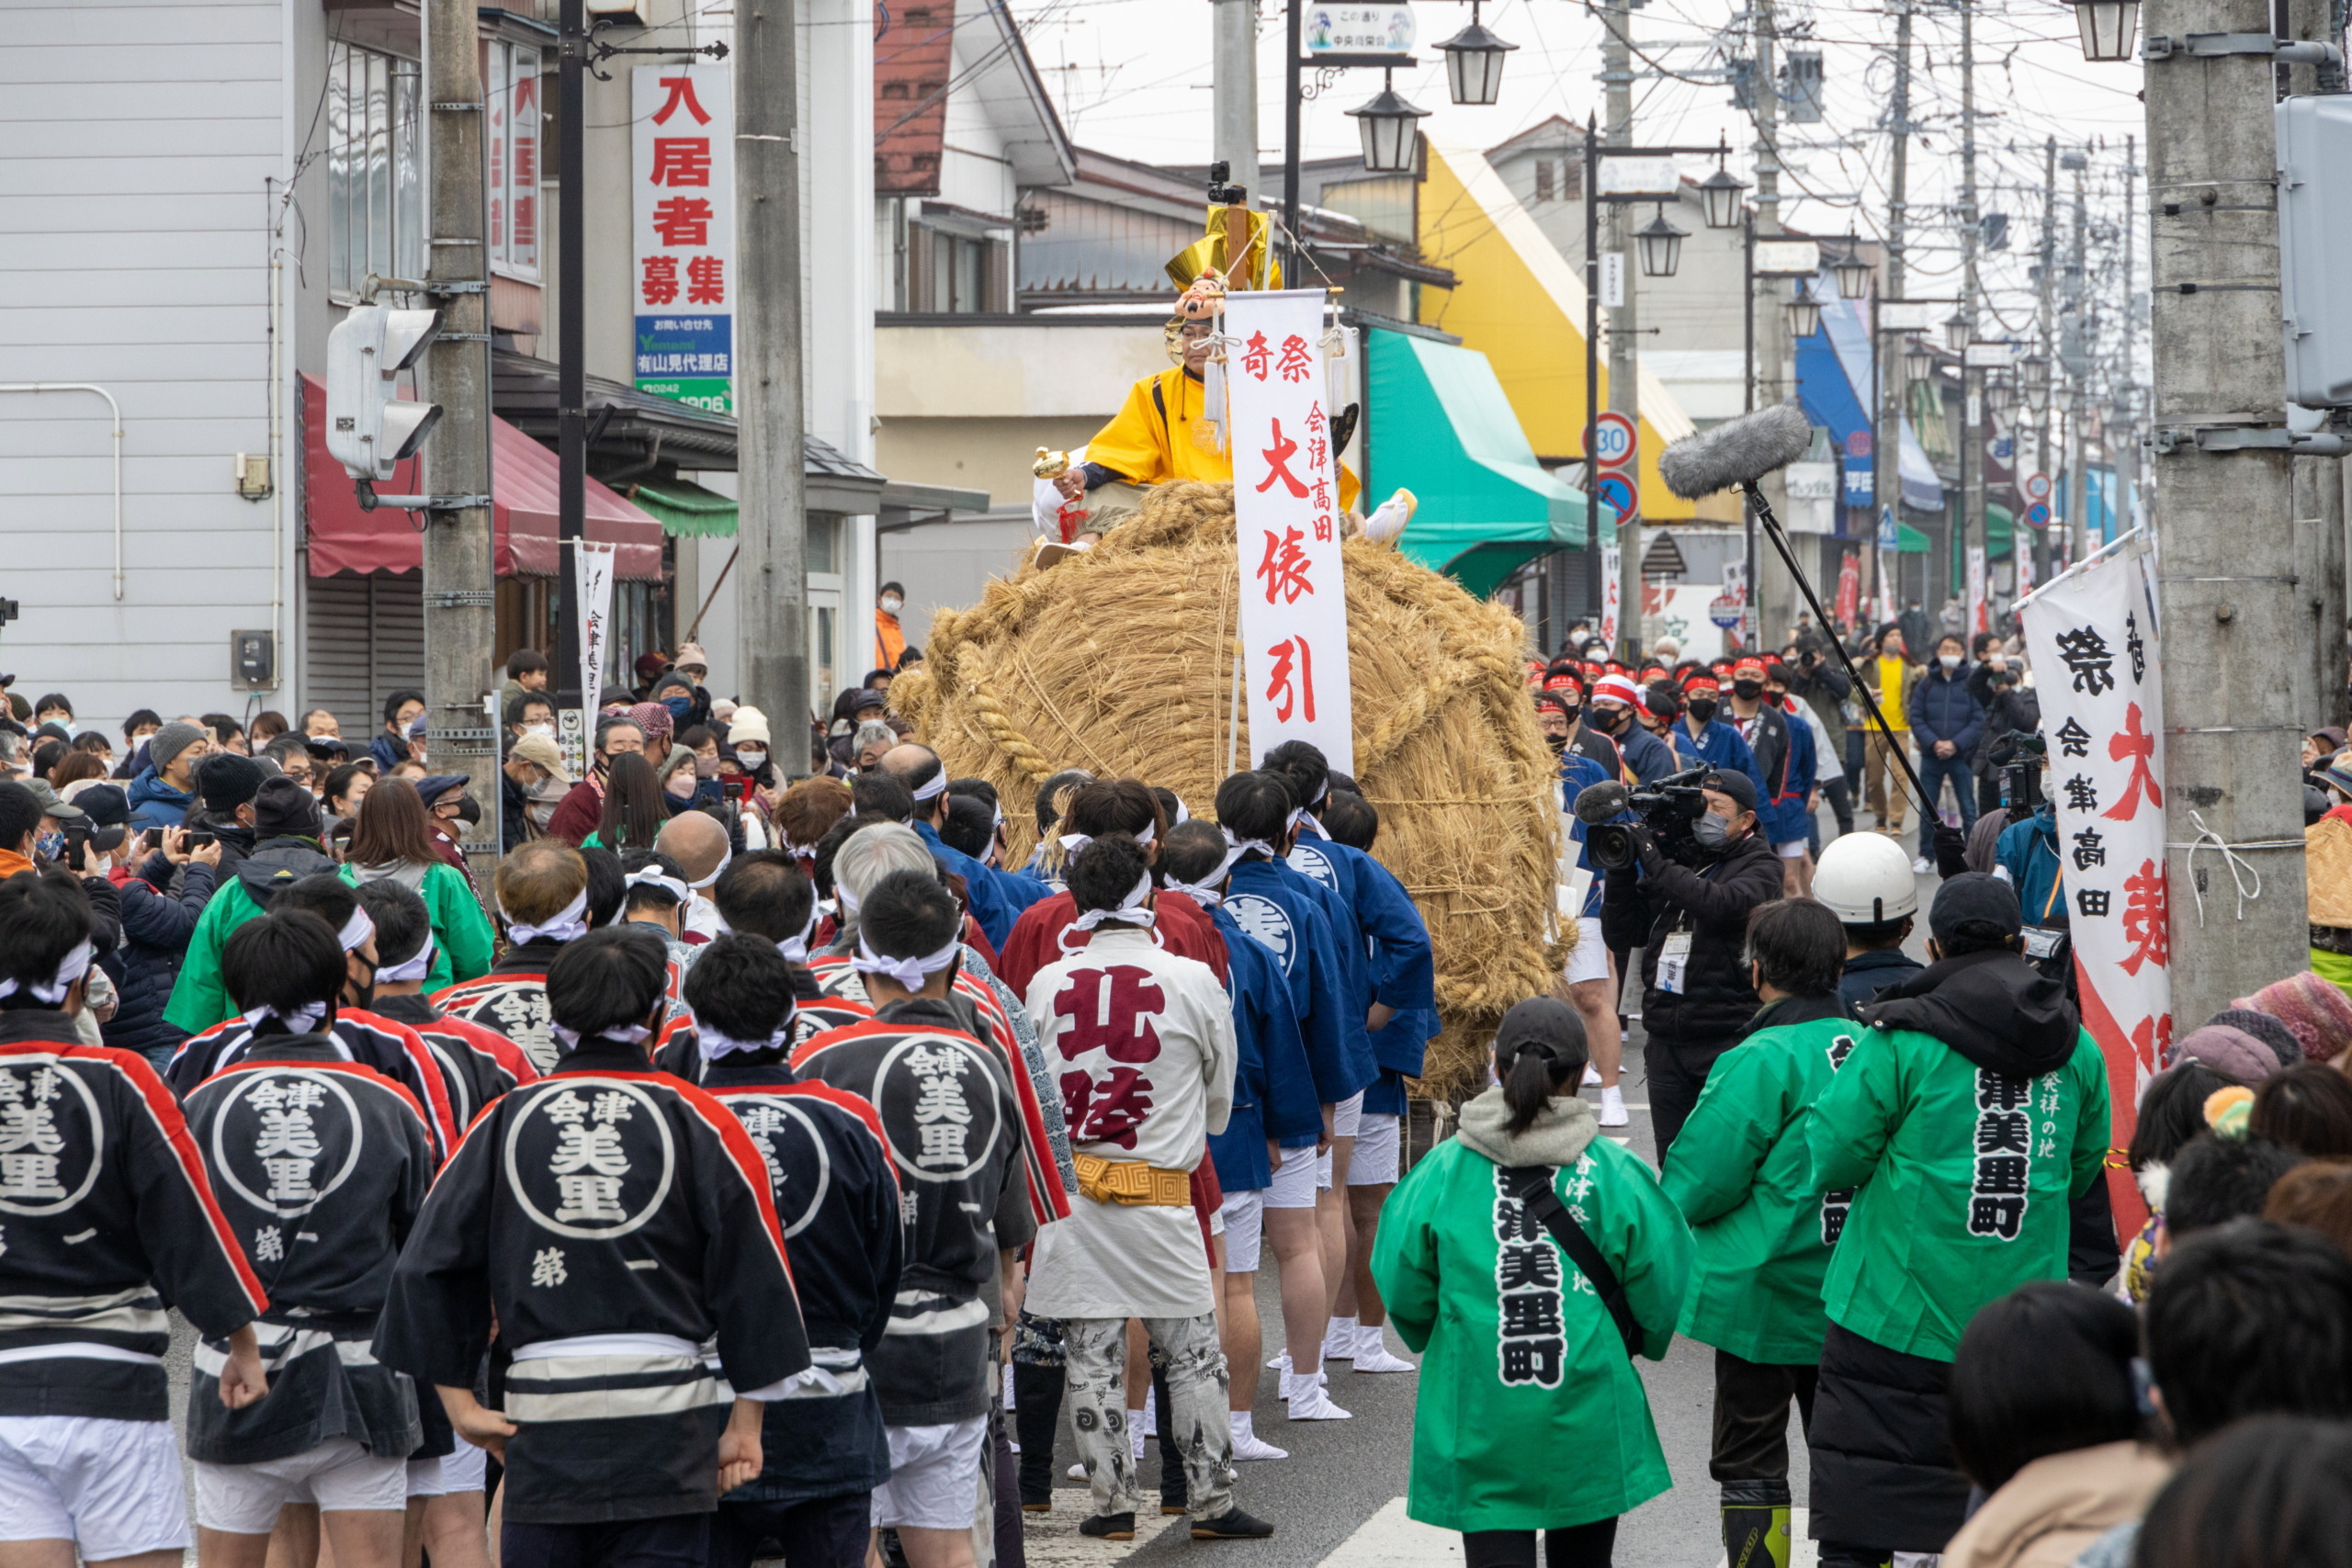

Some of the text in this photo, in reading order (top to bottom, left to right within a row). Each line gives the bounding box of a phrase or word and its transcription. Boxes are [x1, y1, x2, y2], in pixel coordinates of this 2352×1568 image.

[650, 77, 713, 246] 入居者
[641, 255, 725, 306] 募集
[654, 319, 713, 331] お問い合せ先
[1240, 330, 1313, 384] 奇祭
[1597, 428, 1625, 452] 30
[1255, 416, 1317, 725] 大俵引
[903, 1044, 969, 1077] 会津
[1054, 964, 1165, 1150] 北陸
[244, 1079, 327, 1111] 会津
[543, 1090, 637, 1124] 会津
